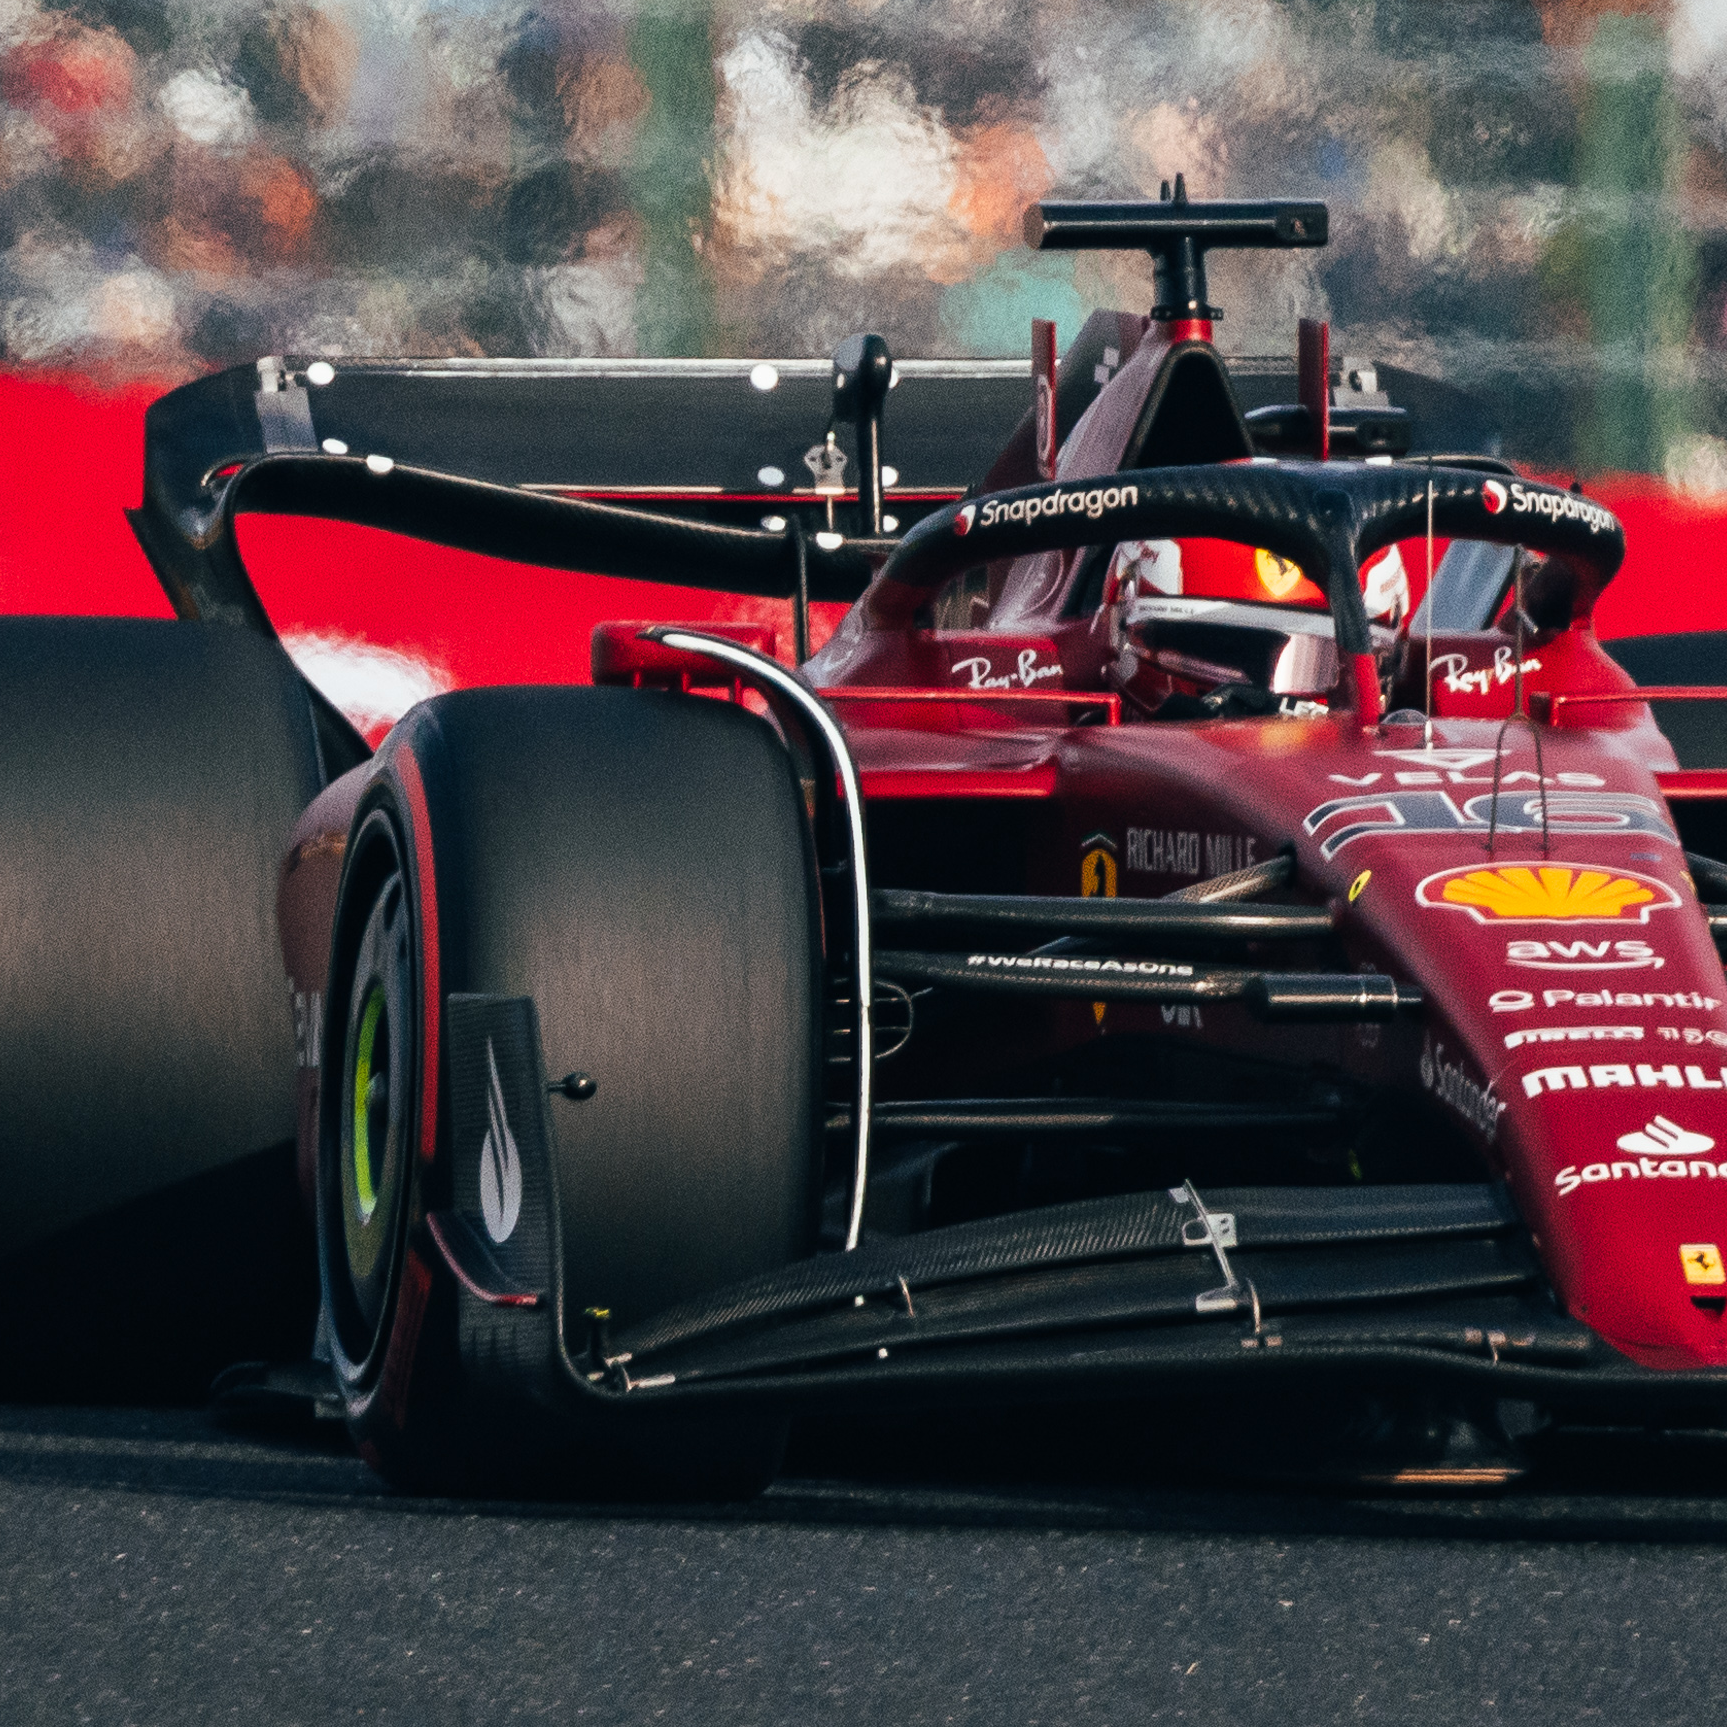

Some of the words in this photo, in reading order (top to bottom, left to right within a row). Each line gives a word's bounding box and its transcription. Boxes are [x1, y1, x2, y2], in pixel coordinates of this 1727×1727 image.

[980, 486, 1138, 526] Snapdragon
[1510, 483, 1615, 535] Snapdragon
[952, 649, 1063, 689] Ray-Ban
[1329, 771, 1606, 787] VELAS
[1127, 827, 1200, 874] RICHARD
[968, 955, 1193, 976] #WeRaceAsOne
[1507, 941, 1655, 960] aws
[1542, 989, 1722, 1011] Palantir
